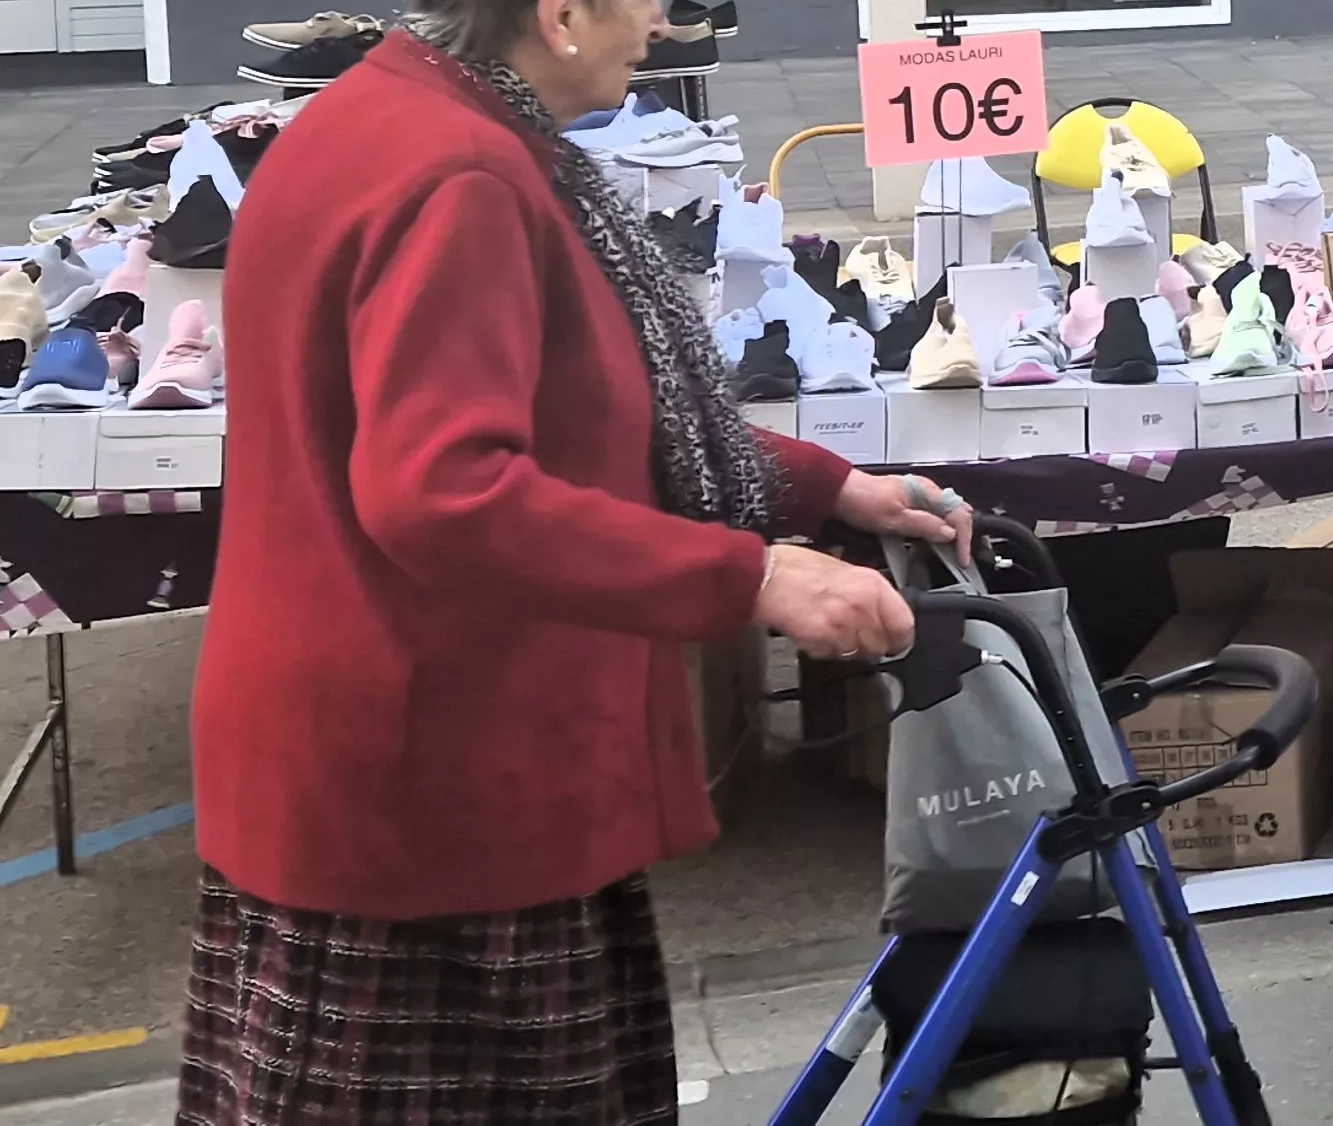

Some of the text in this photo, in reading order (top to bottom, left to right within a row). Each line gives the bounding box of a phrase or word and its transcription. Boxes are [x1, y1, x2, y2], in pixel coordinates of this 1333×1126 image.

[899, 46, 1003, 66] MODAS LAURI
[888, 77, 1024, 144] 10€
[917, 768, 1047, 816] MULAYA
